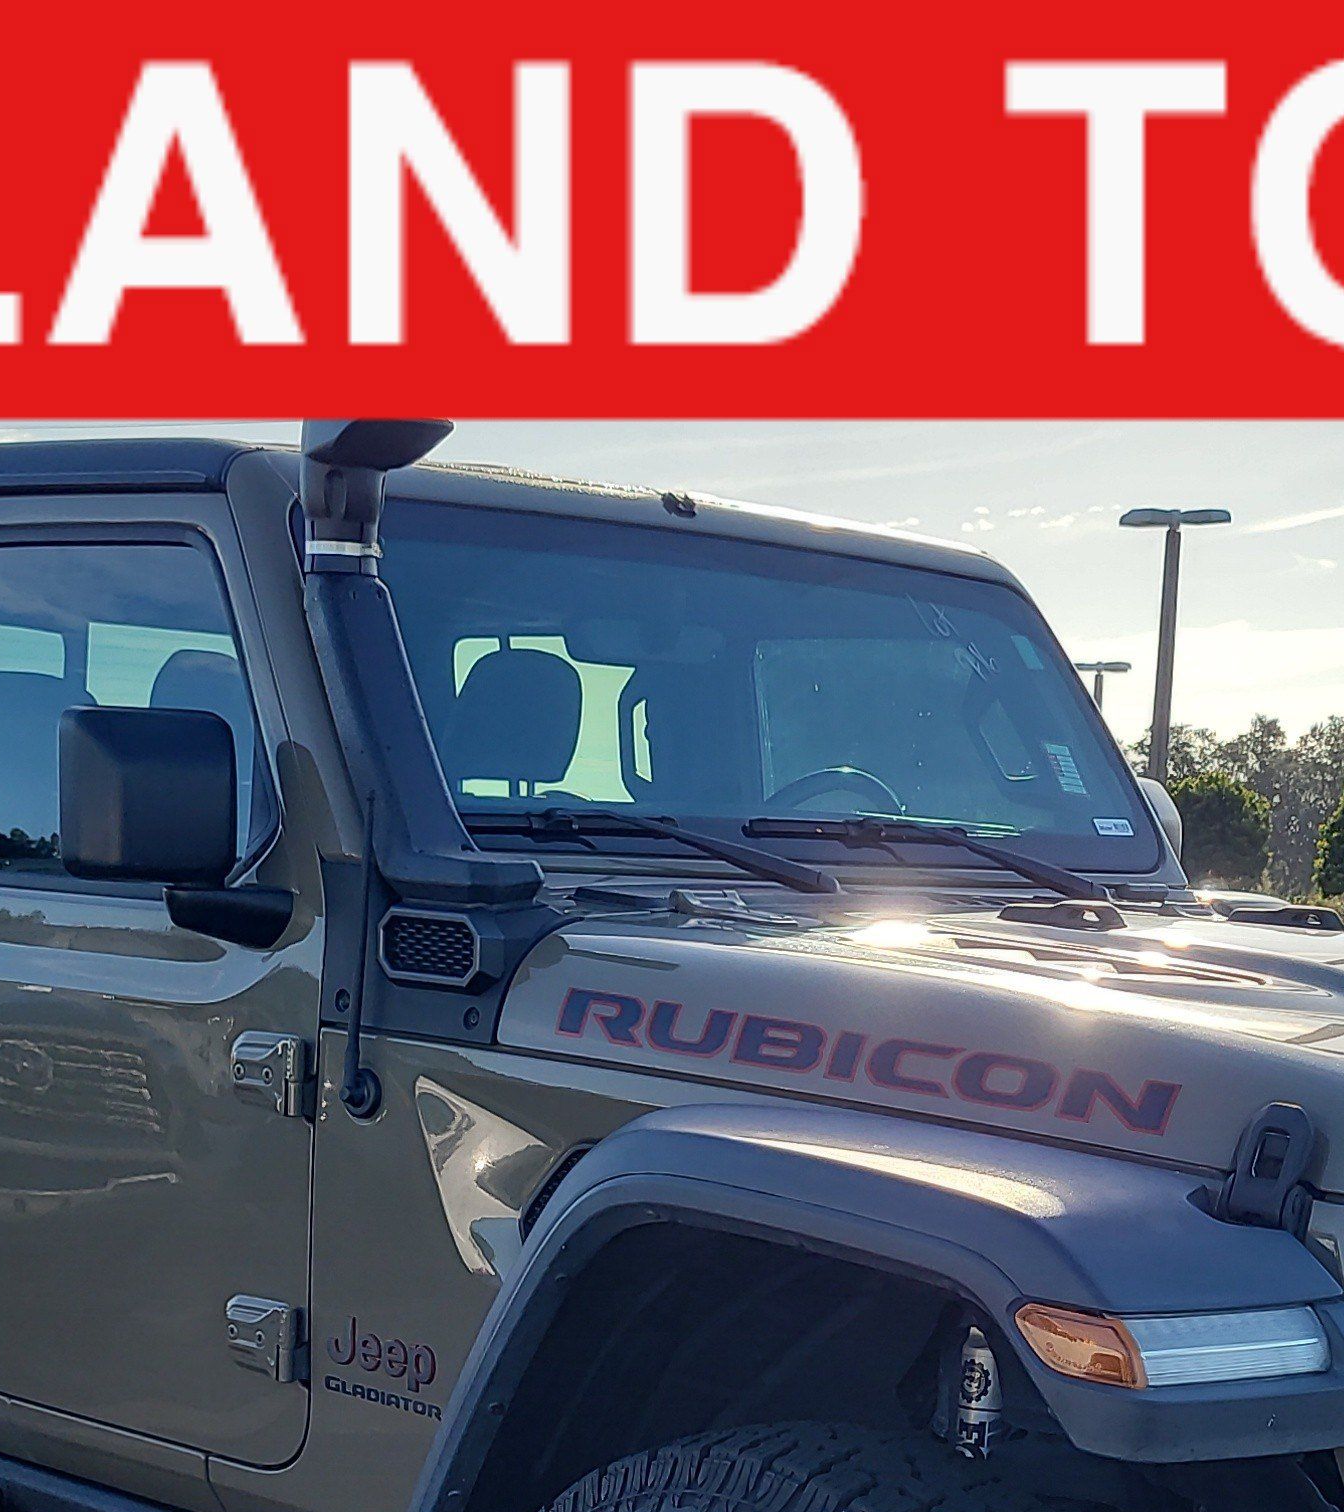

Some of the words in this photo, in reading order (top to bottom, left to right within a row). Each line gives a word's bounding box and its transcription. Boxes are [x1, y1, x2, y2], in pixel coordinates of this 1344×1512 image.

[556, 987, 1182, 1136] RUBICON
[327, 1315, 437, 1393] Jeep
[324, 1375, 442, 1422] GLADIATOR
